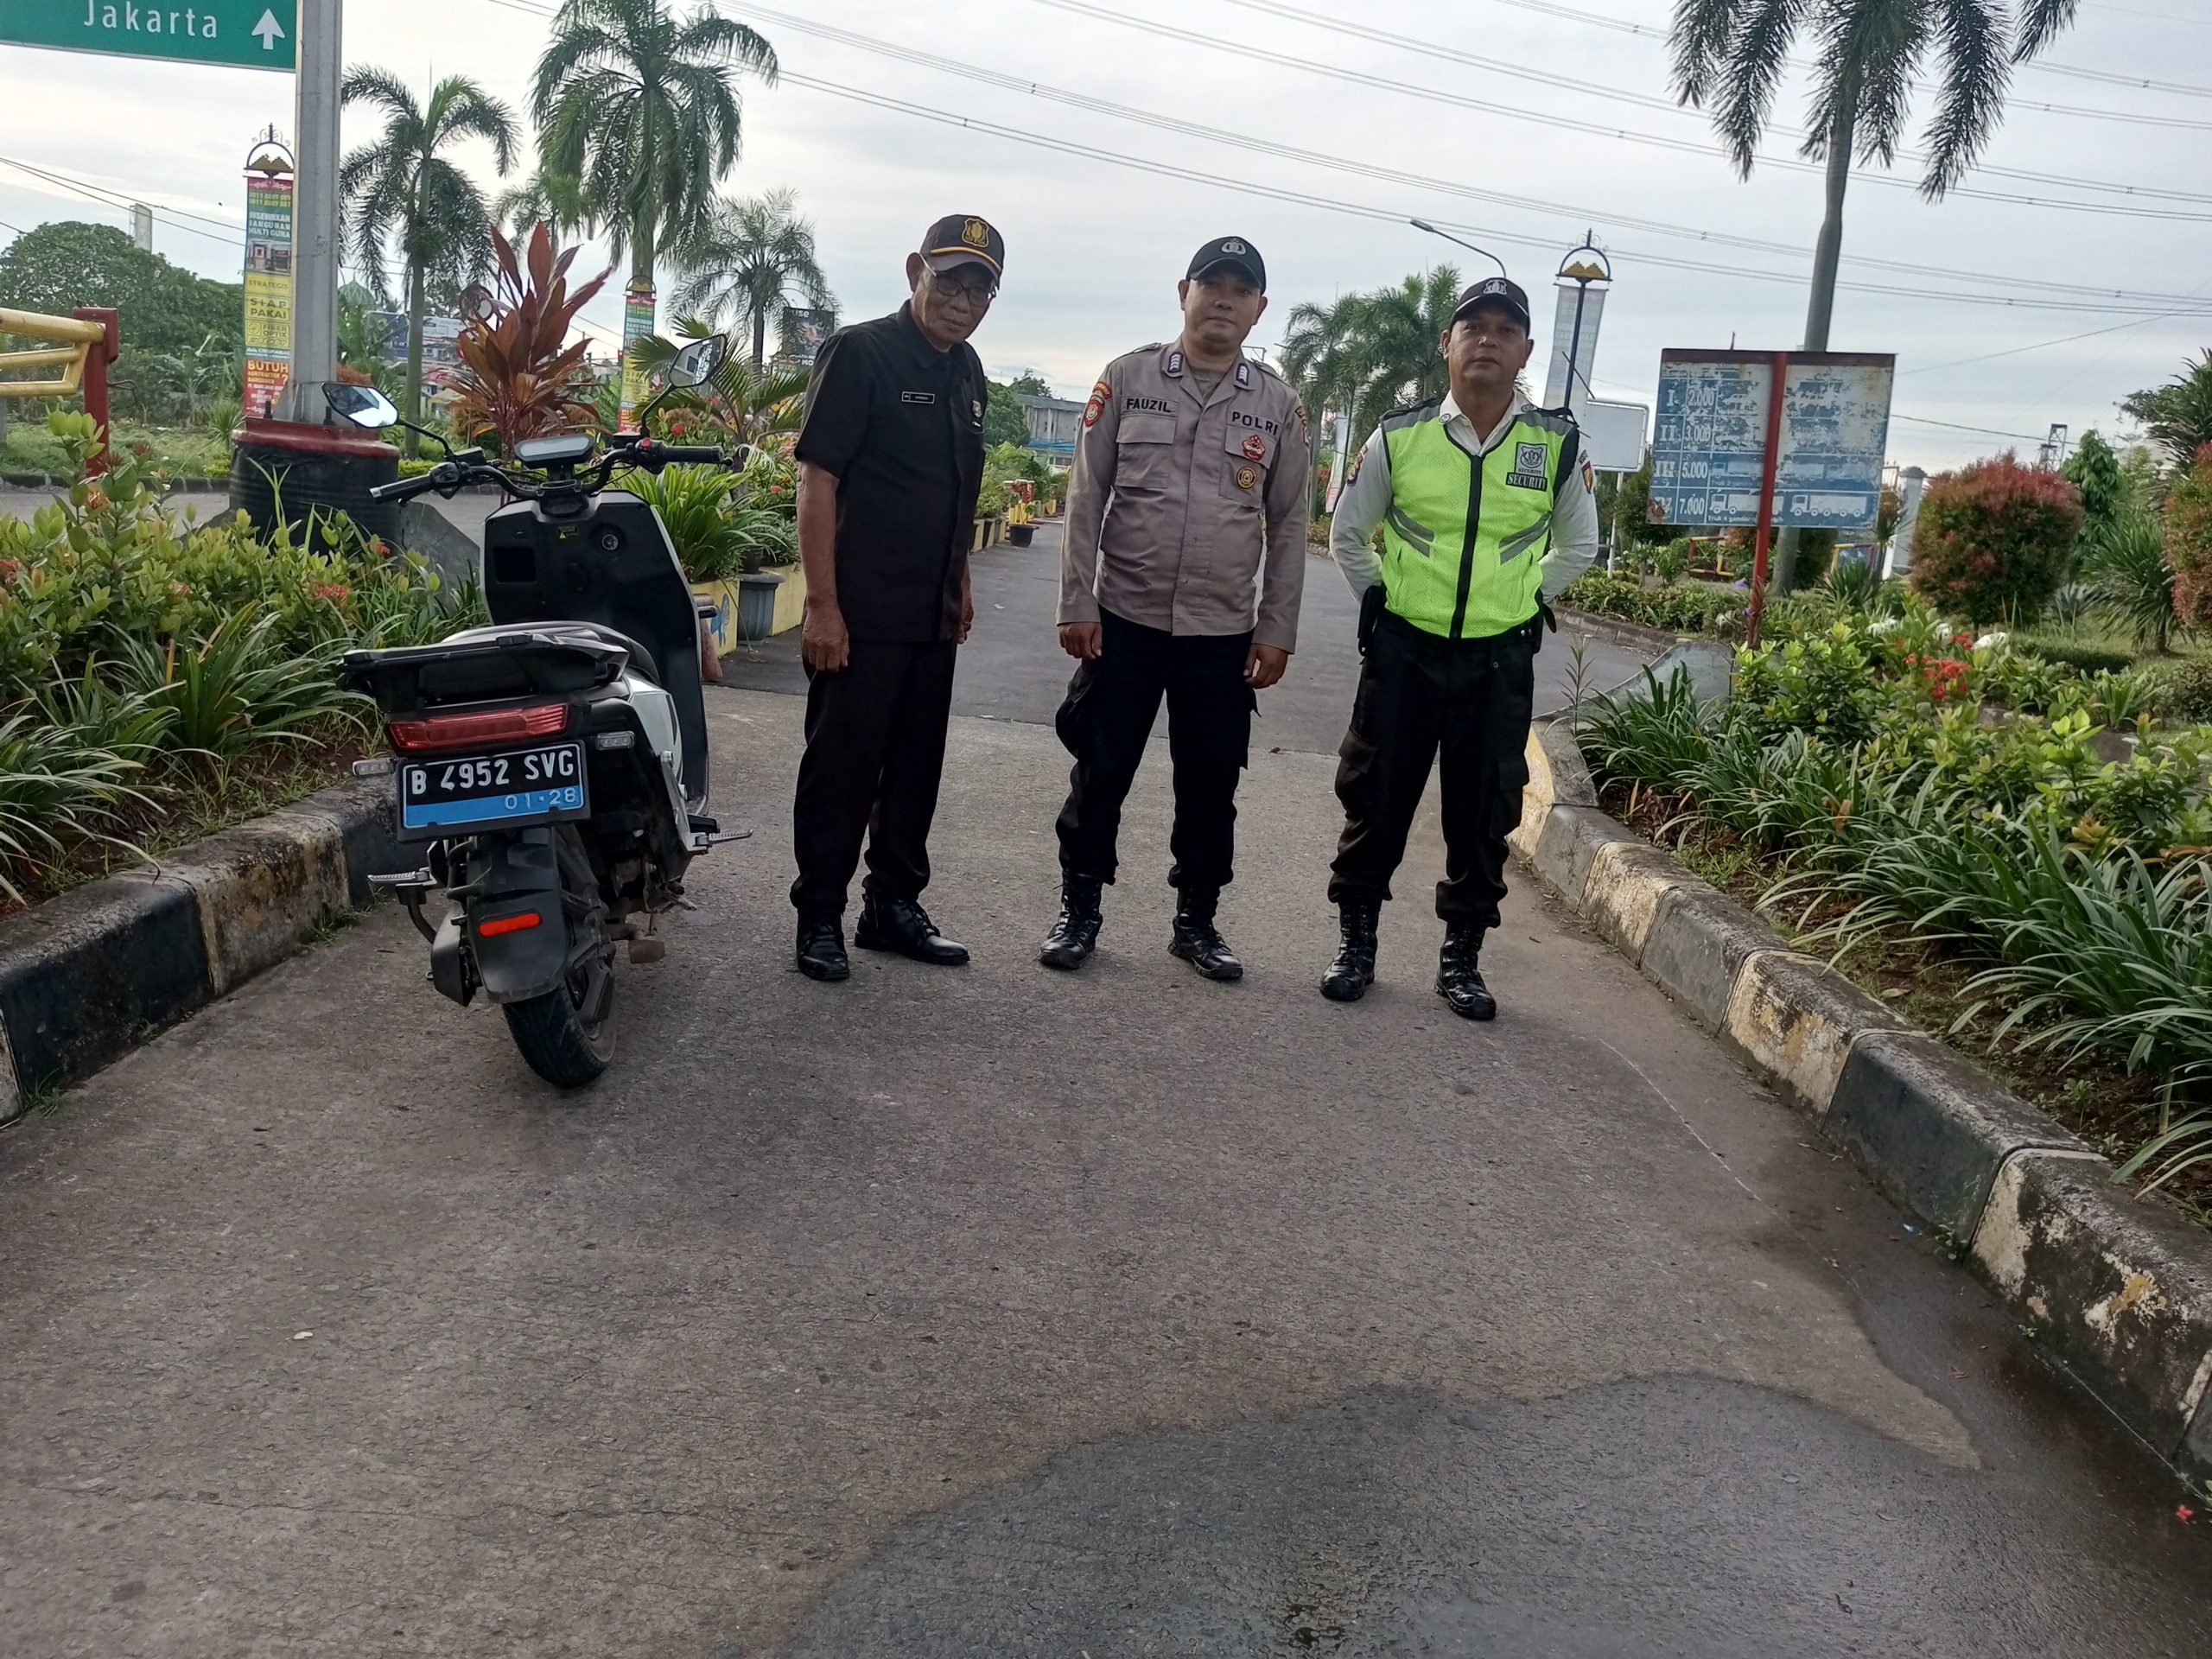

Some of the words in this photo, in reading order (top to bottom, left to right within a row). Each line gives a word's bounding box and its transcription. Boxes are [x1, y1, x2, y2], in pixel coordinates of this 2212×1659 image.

[84, 0, 217, 38] Jakarta
[251, 308, 286, 319] PAKAI
[248, 360, 289, 372] BUTUH
[1126, 398, 1172, 412] FAUZIL
[1688, 389, 1715, 407] 2.000
[1232, 411, 1279, 435] POLRI
[1681, 461, 1708, 479] 5.000
[1679, 497, 1705, 515] 7.000
[411, 770, 427, 795] B
[441, 759, 510, 791] 4952
[524, 750, 574, 780] SVG
